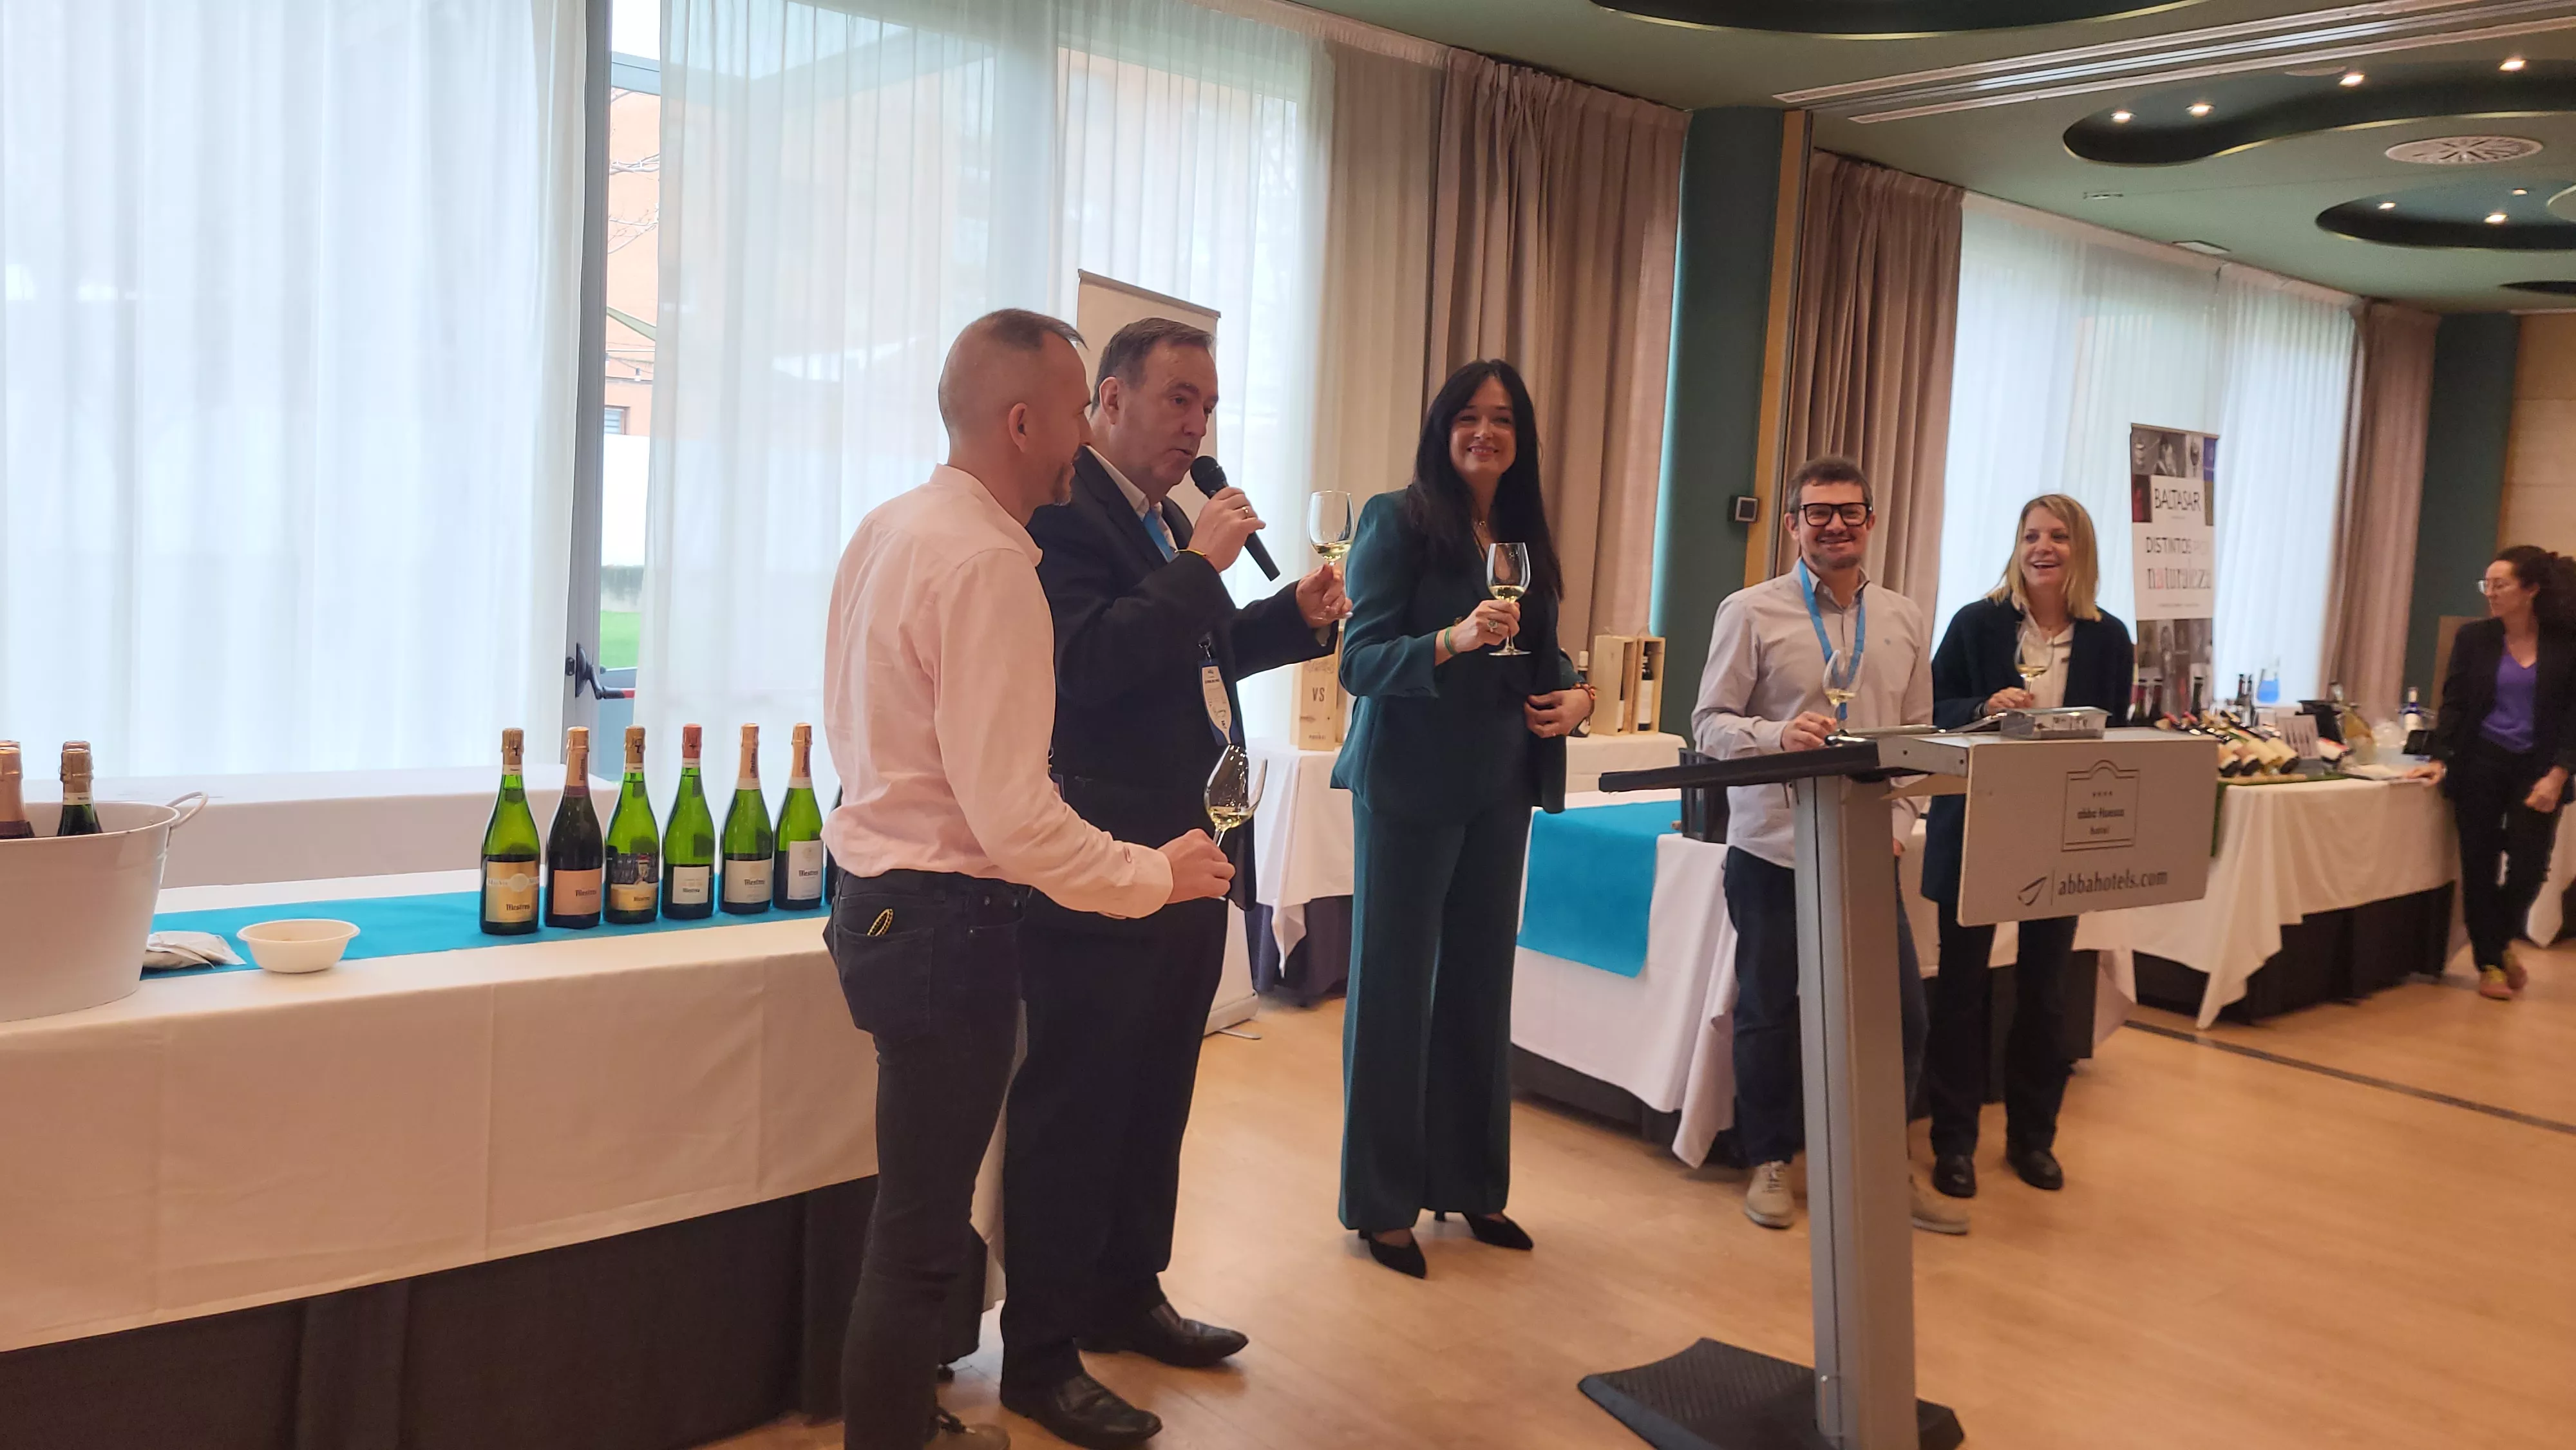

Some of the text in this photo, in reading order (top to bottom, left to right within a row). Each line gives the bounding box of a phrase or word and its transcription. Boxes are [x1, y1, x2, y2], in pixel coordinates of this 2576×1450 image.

[2154, 487, 2201, 512] BALTASAR
[1312, 686, 1325, 702] VS
[2058, 869, 2168, 896] abbahotels.com
